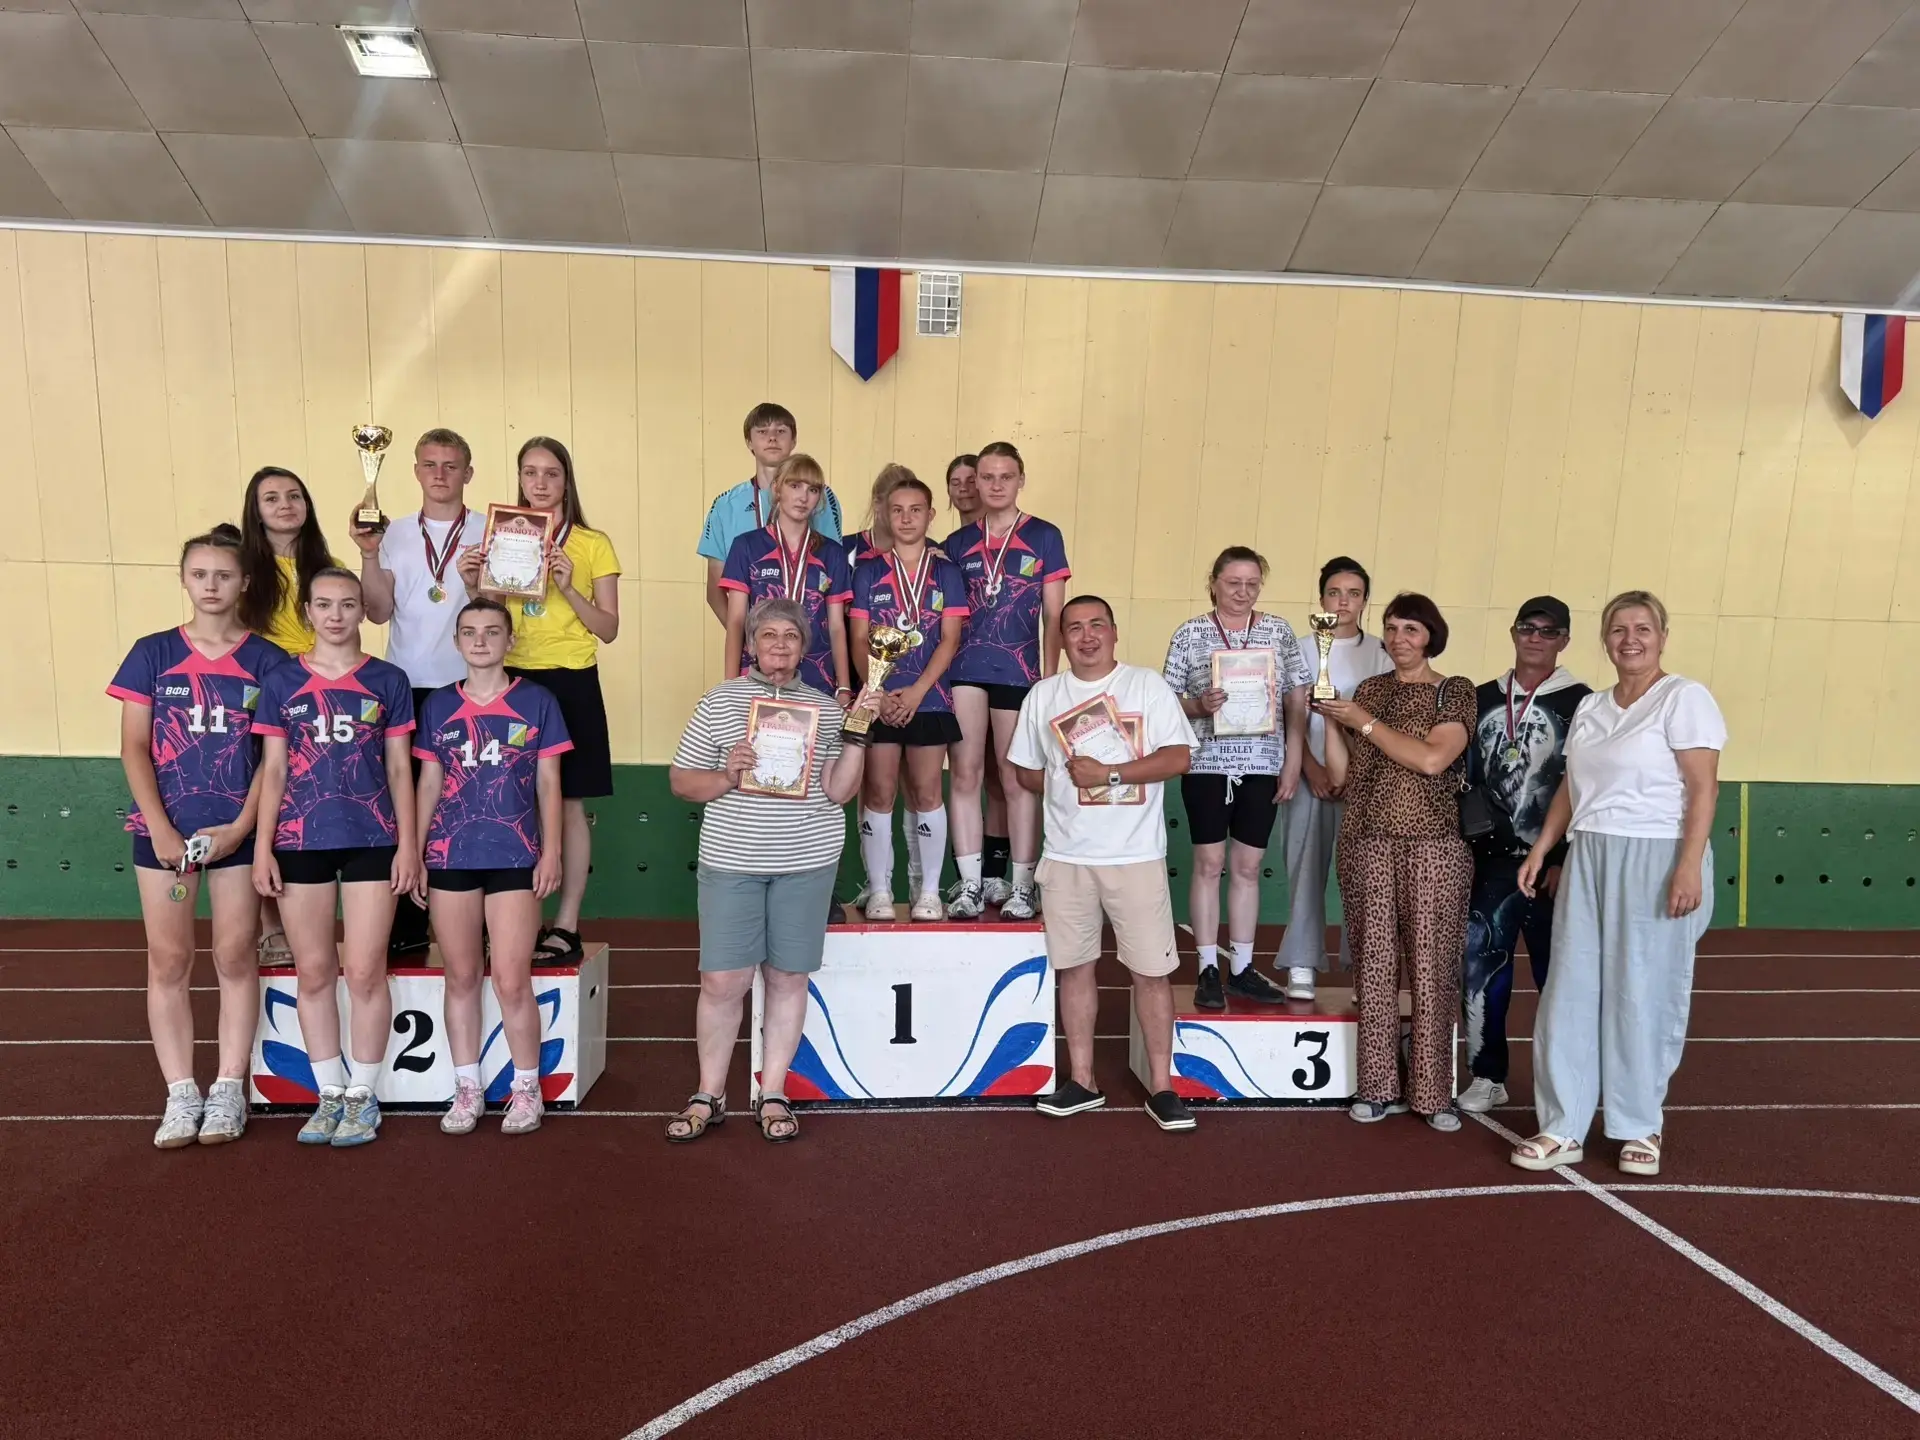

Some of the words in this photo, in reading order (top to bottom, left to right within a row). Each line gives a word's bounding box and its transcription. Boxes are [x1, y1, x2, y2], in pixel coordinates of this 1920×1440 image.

[165, 686, 190, 696] ВФВ
[188, 704, 228, 733] 11
[312, 714, 354, 743] 15
[460, 739, 502, 767] 14
[1219, 745, 1254, 754] HEALEY
[889, 983, 917, 1045] 1
[392, 1009, 436, 1073] 2
[1291, 1030, 1331, 1091] 3
